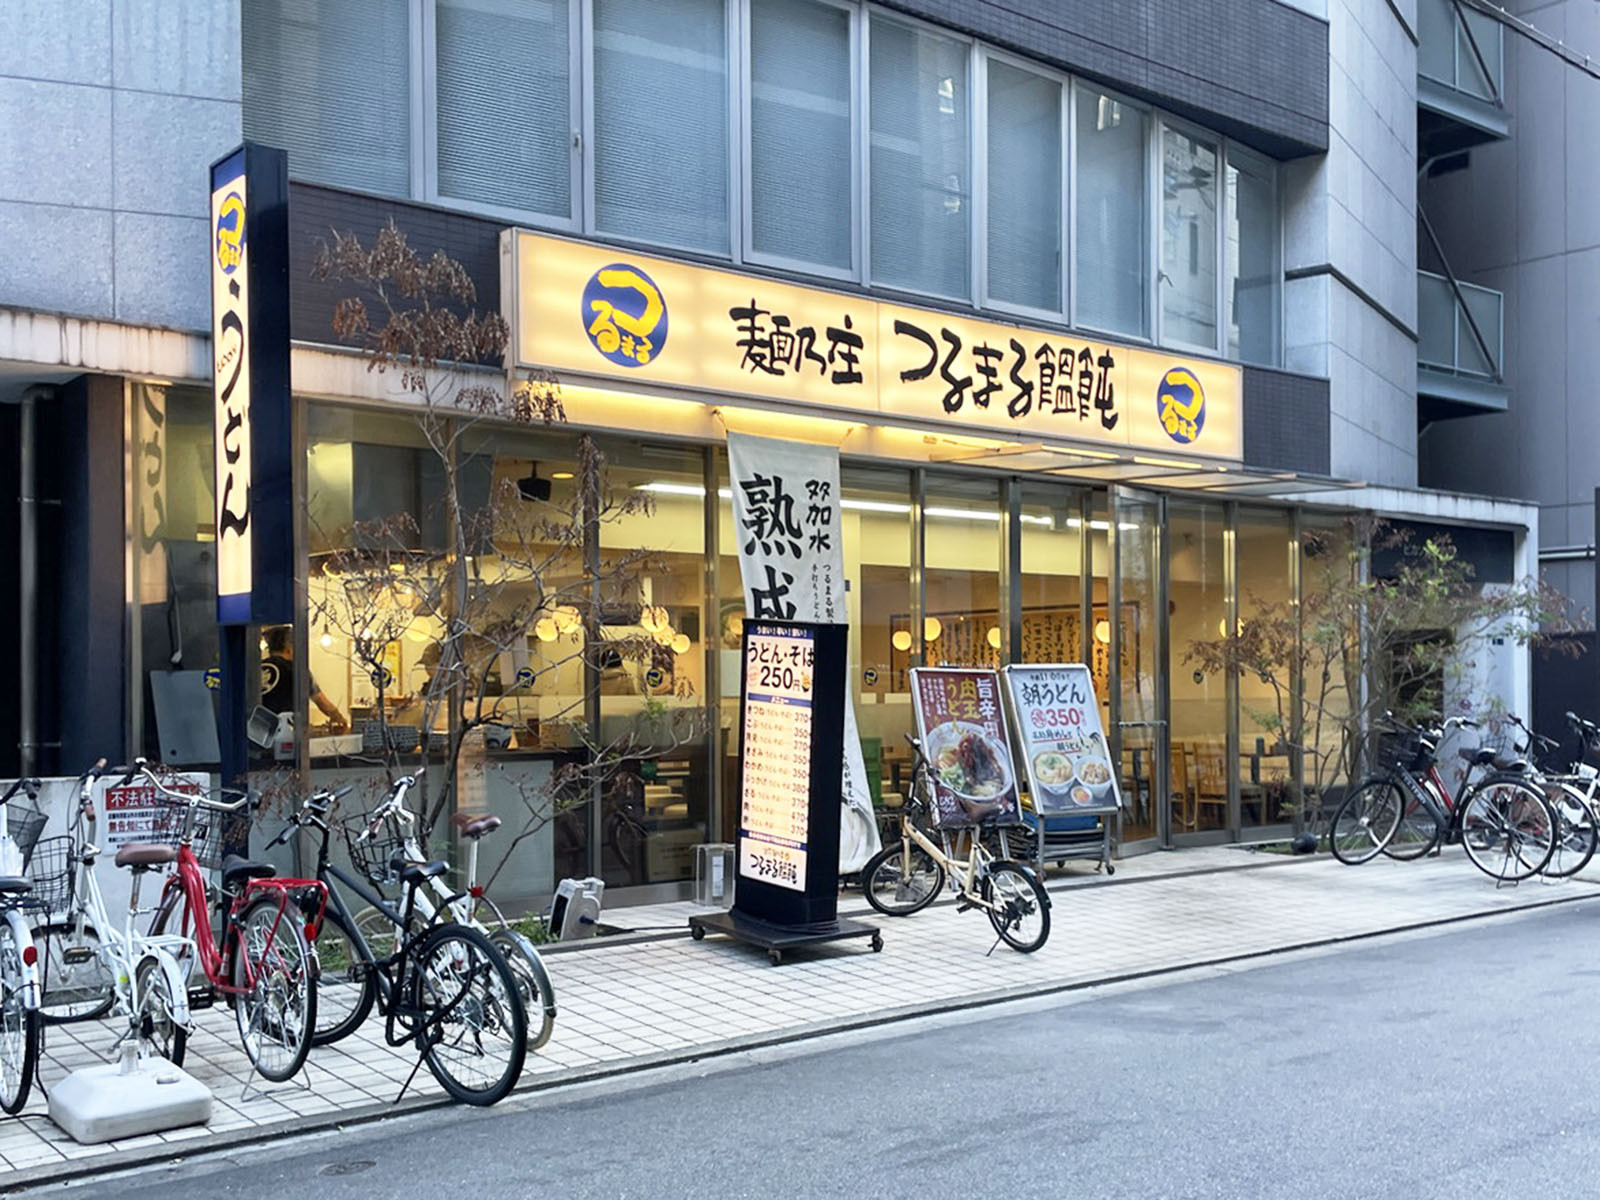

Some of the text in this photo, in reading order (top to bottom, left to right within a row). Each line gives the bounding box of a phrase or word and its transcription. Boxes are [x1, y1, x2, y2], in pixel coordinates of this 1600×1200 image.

[218, 278, 251, 538] うどん
[894, 319, 1119, 431] つるまる饂飩
[1022, 682, 1086, 707] 朝うどん
